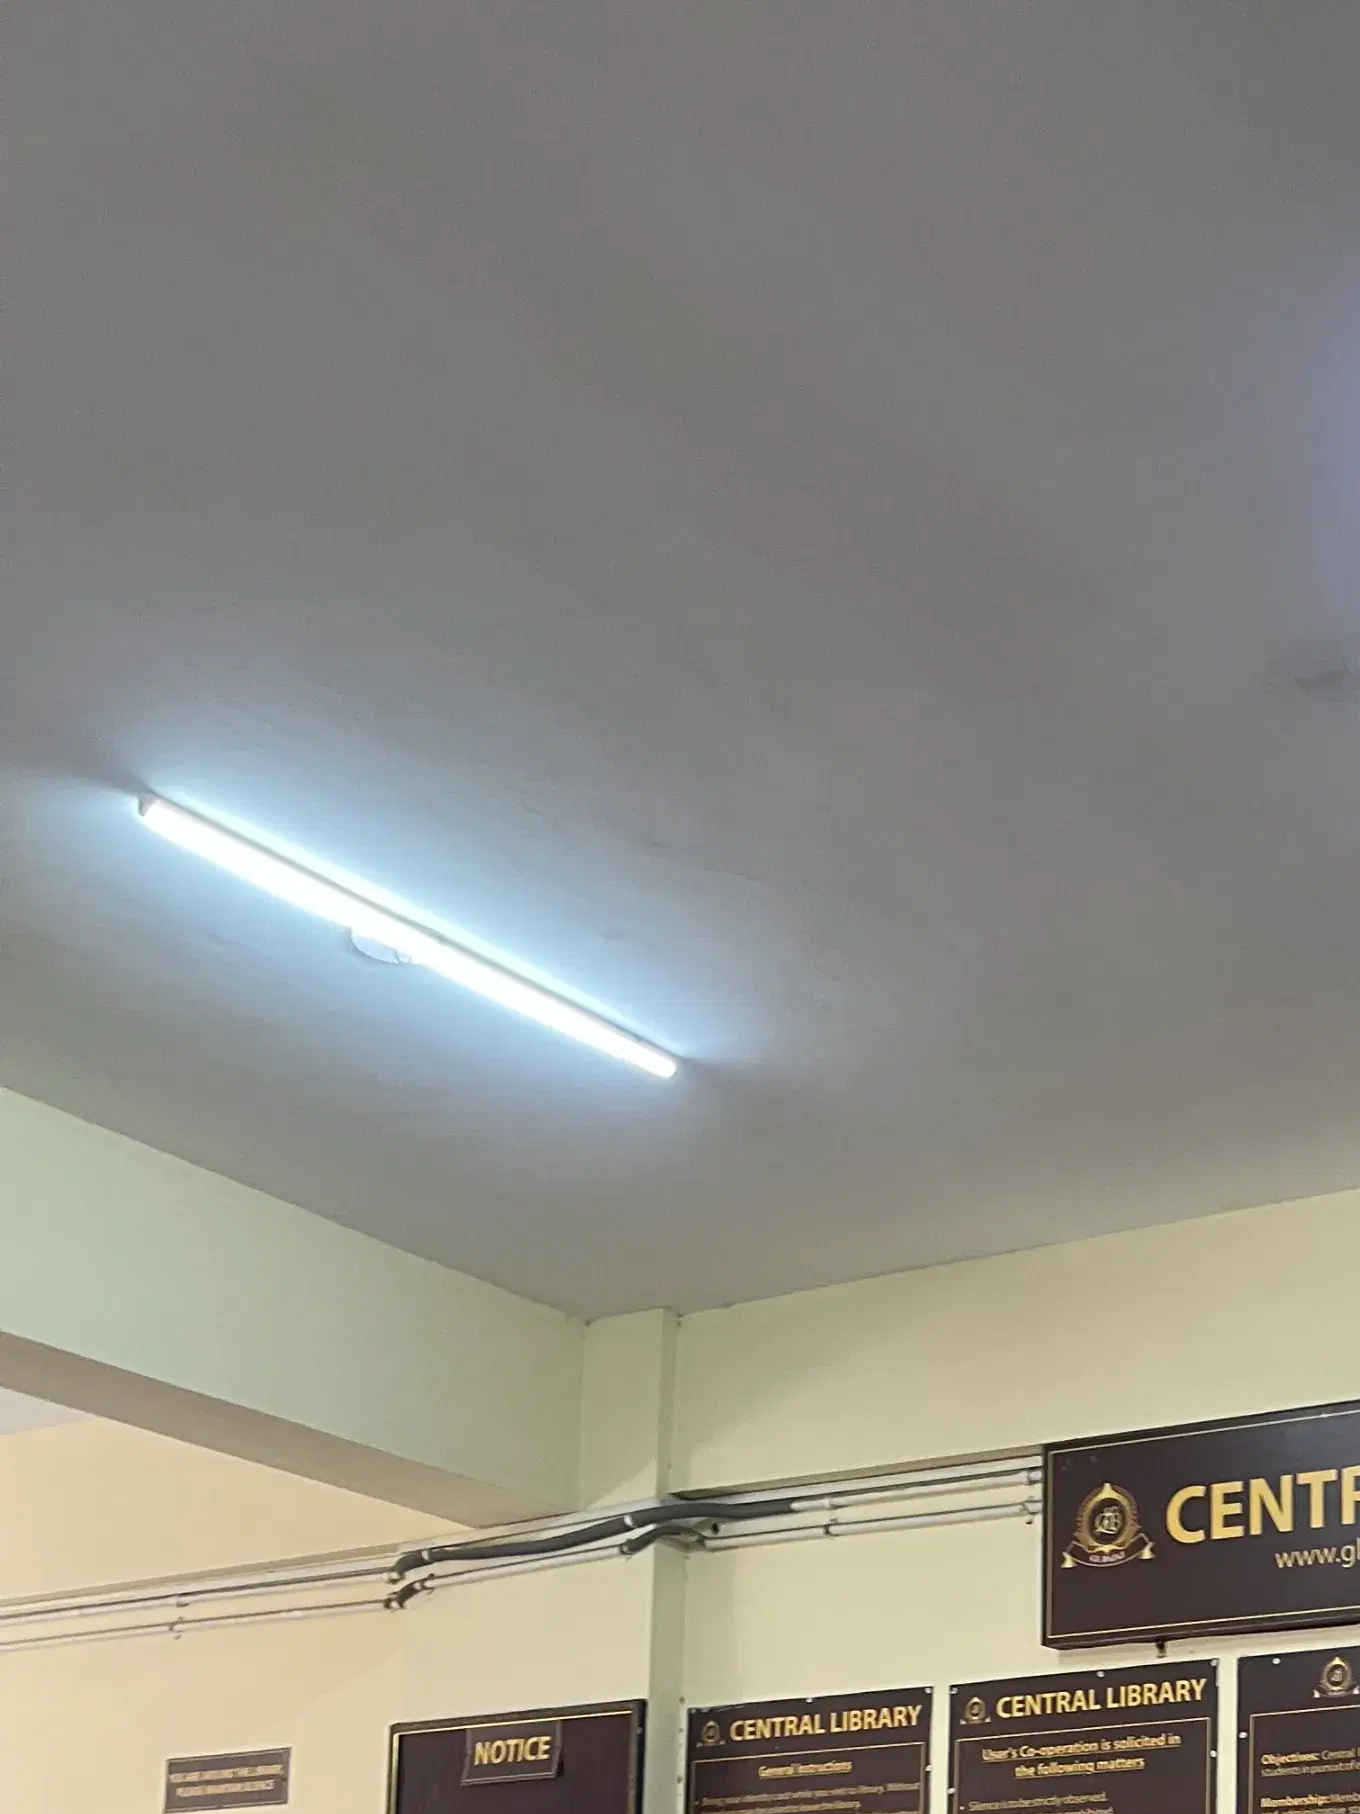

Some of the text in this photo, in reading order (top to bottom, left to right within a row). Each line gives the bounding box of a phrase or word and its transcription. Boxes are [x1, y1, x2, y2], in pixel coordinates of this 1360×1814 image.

[996, 1678, 1208, 1719] CENTRAL LIBRARY
[730, 1704, 922, 1741] CENTRAL LIBRARY
[474, 1735, 552, 1766] NOTICE
